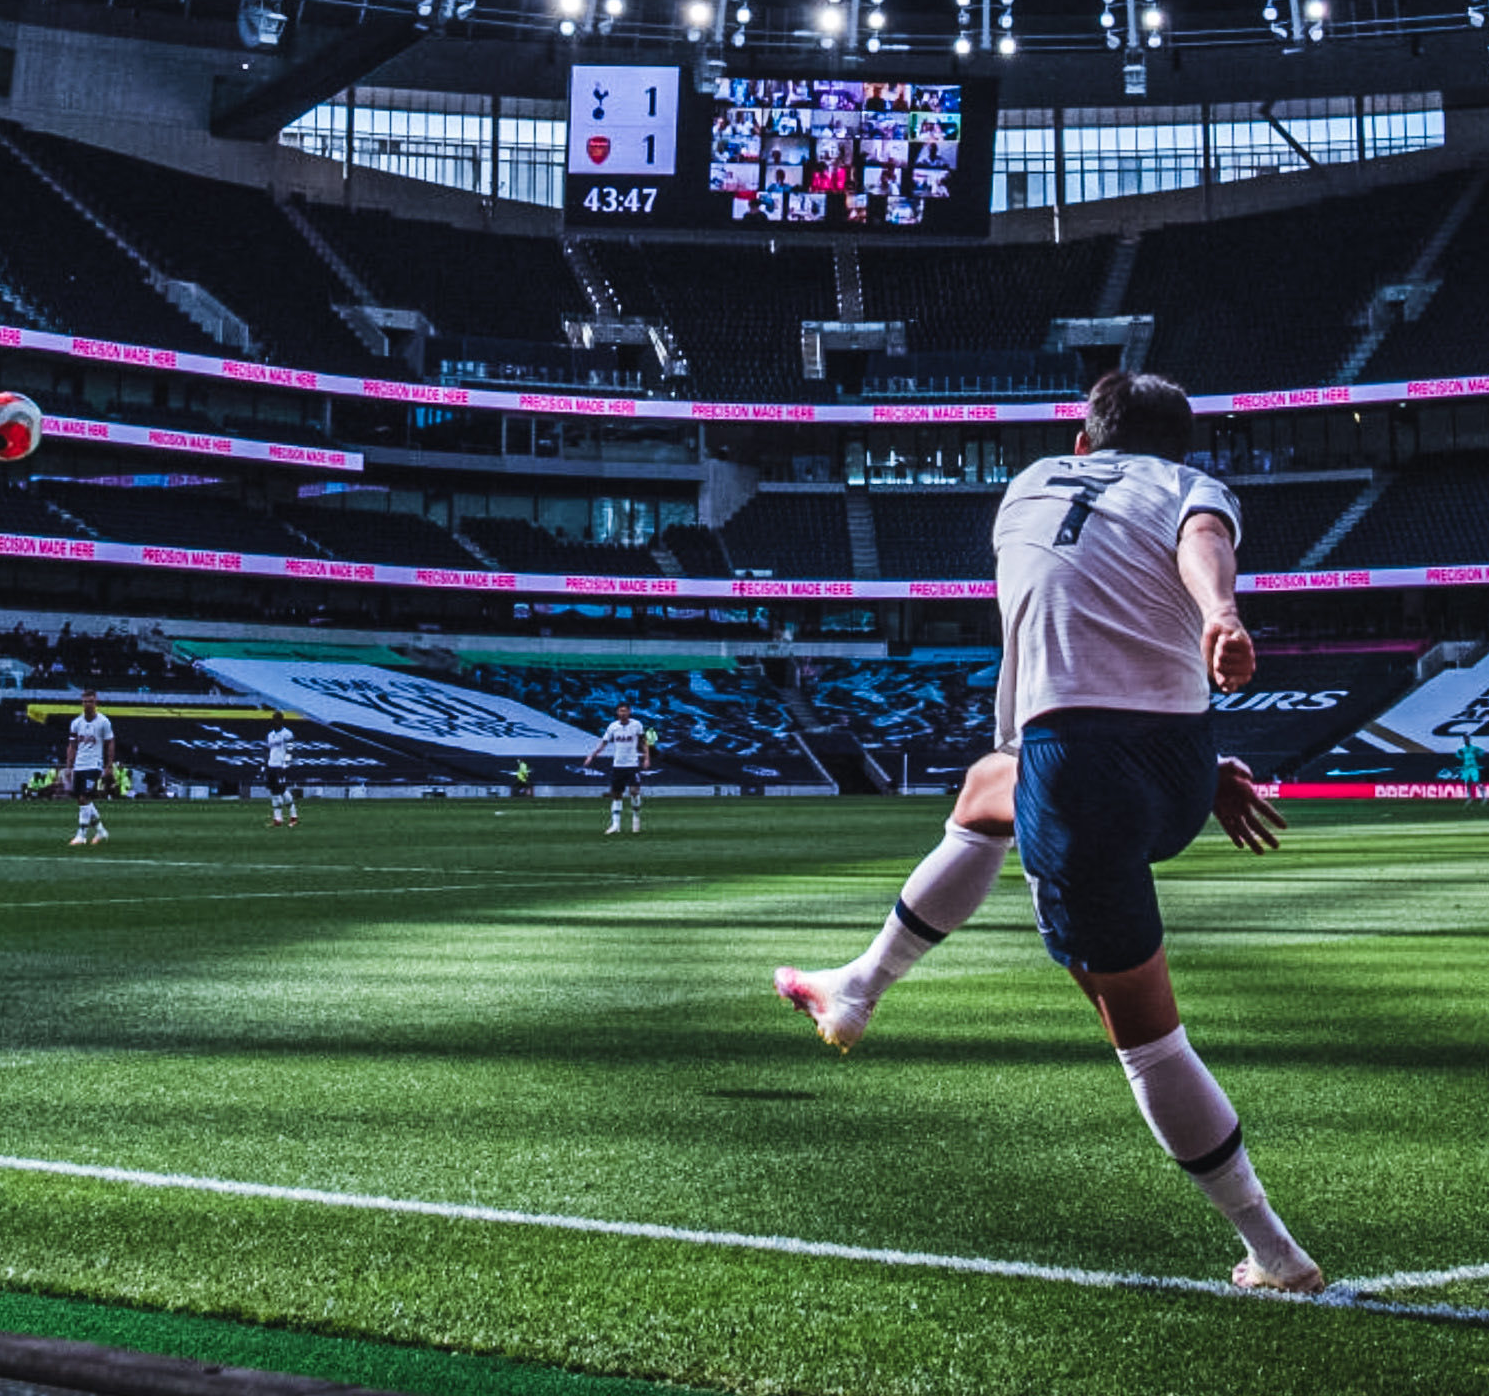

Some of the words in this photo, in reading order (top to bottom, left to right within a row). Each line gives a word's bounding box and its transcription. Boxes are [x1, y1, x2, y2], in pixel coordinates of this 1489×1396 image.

[645, 87, 657, 117] 1
[643, 134, 655, 165] 1
[583, 187, 658, 212] 43:47
[1408, 381, 1463, 398] PRECISION
[692, 404, 748, 420] PRECISION
[753, 406, 782, 420] MADE
[787, 407, 814, 421] HERE
[874, 406, 928, 422] PRECISION
[933, 407, 963, 422] MADE
[968, 407, 996, 420] HERE
[1045, 475, 1125, 546] 7
[1427, 569, 1482, 584] PRECISION
